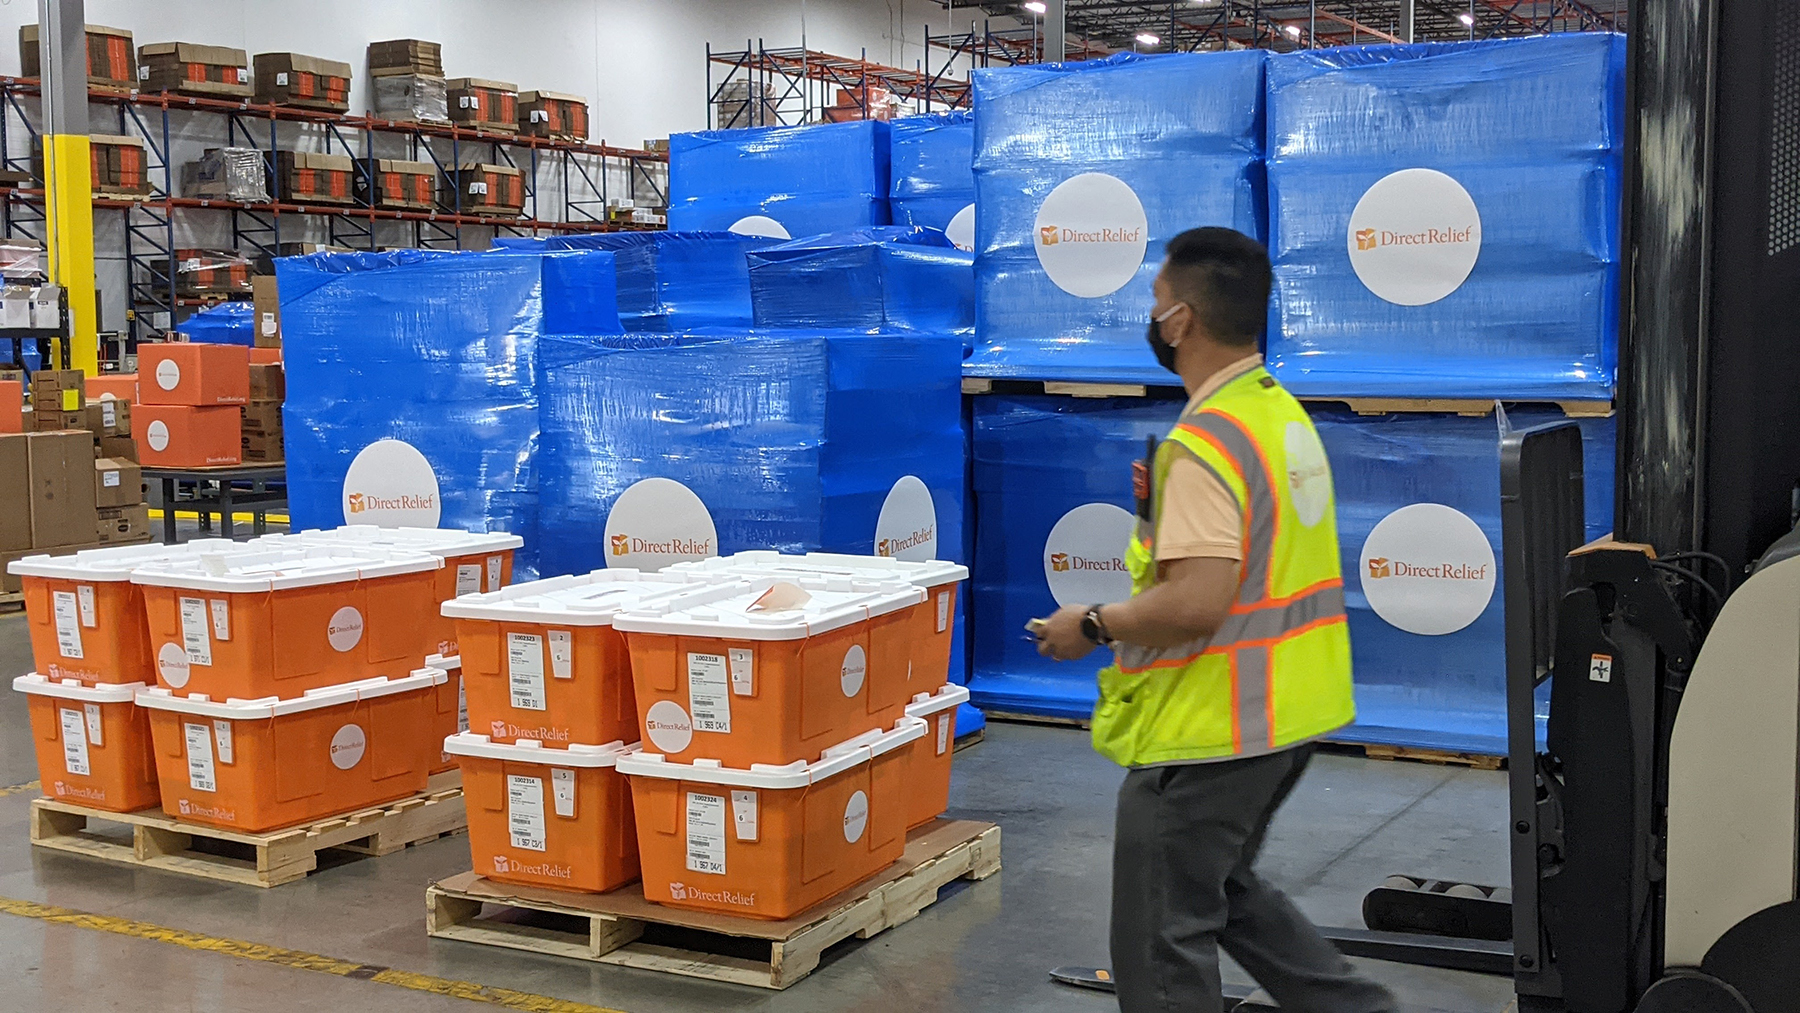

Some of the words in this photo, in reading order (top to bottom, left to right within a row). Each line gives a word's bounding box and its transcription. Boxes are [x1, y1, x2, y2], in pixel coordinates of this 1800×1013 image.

[1062, 228, 1101, 242] Direct
[1103, 227, 1140, 242] Relief
[1381, 231, 1426, 246] Direct
[1428, 225, 1473, 244] Relief
[367, 495, 400, 509] Direct
[401, 493, 434, 509] Relief
[632, 538, 671, 553] Direct
[672, 537, 711, 554] Relief
[891, 537, 912, 554] Direct
[913, 524, 934, 546] Relief
[1073, 556, 1110, 570] Direct
[1394, 562, 1441, 578] Direct
[1442, 563, 1488, 579] Relief
[508, 724, 539, 738] Direct
[540, 727, 569, 740] Relief
[511, 860, 541, 875] Direct
[542, 864, 571, 878] Relief
[688, 887, 722, 902] Direct
[723, 890, 755, 906] Relief
